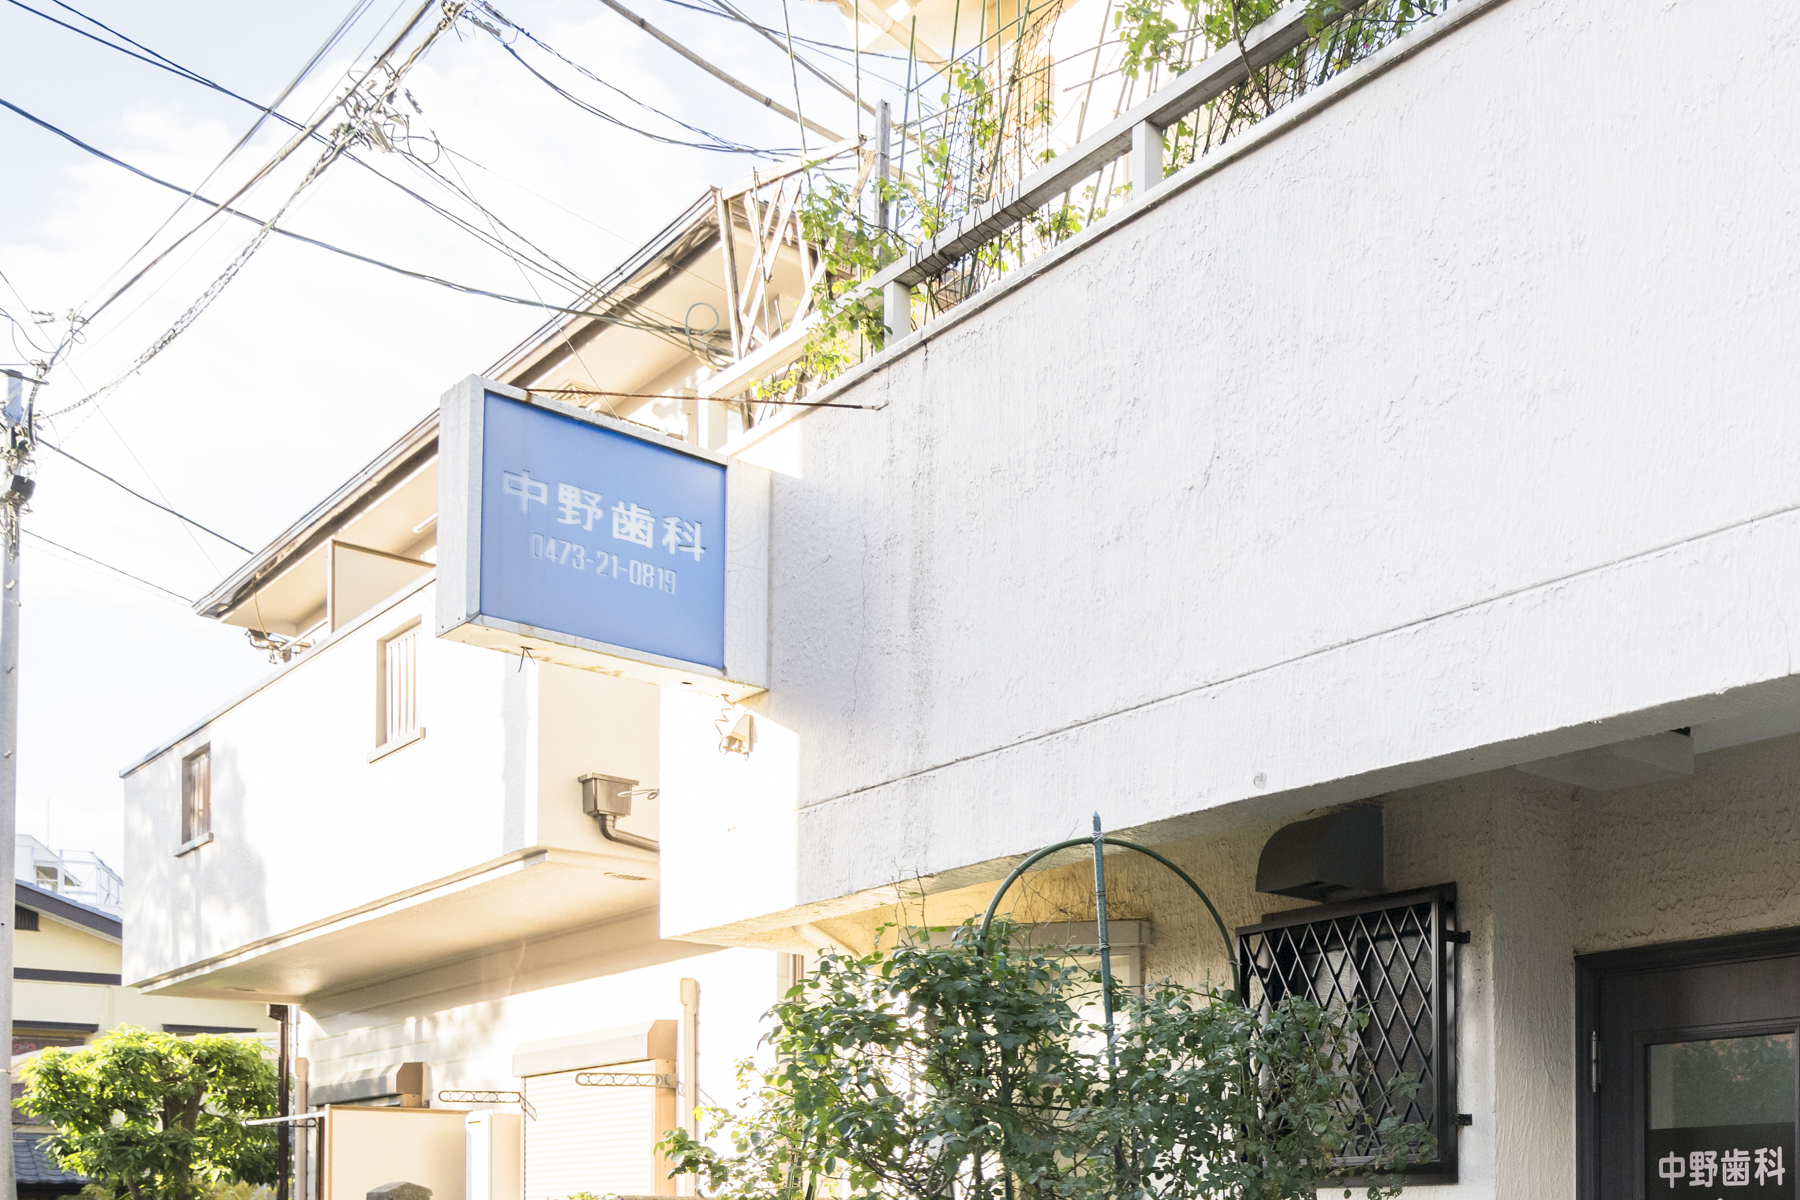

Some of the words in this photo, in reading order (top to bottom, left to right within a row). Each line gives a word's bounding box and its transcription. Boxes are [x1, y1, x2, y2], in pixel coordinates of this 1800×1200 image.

[503, 469, 706, 562] 中野歯科
[531, 532, 677, 594] 0473-21-0819
[1658, 1146, 1786, 1189] 中野歯科
